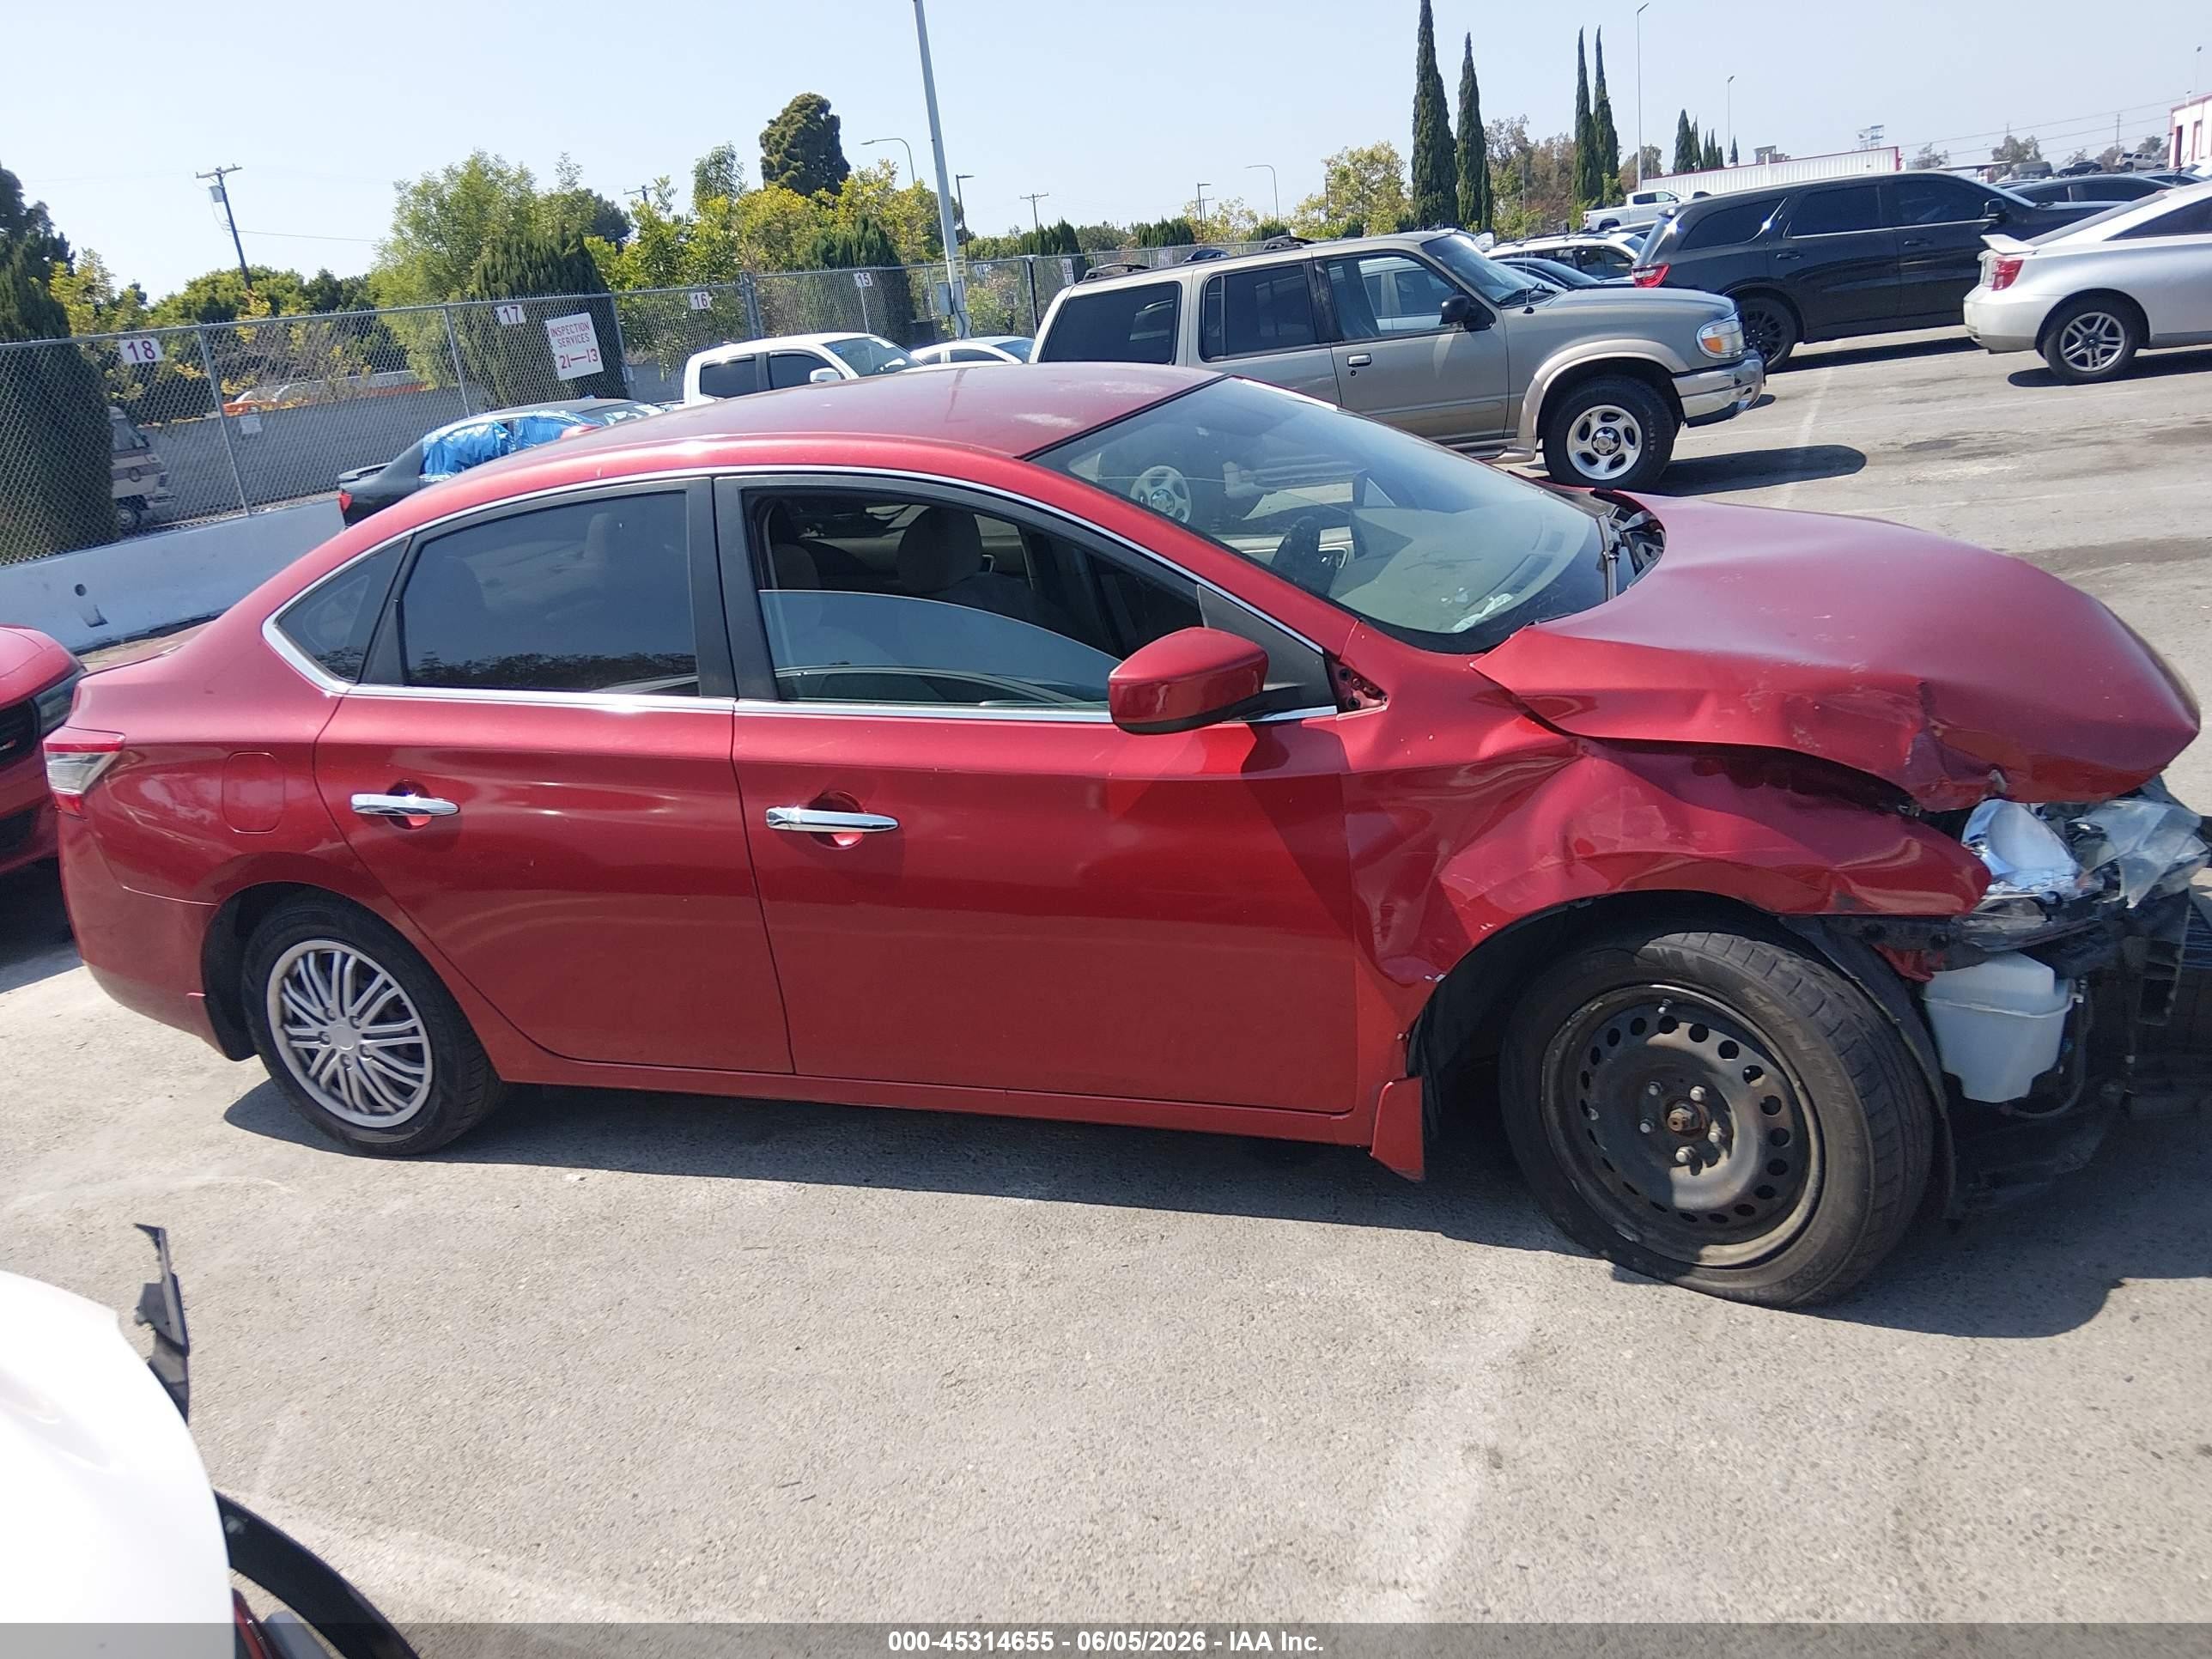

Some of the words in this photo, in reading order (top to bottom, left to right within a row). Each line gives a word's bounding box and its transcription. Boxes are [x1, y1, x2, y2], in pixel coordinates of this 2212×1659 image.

[858, 273, 870, 286] 15
[694, 293, 708, 308] 16
[503, 306, 520, 324] 17
[550, 322, 591, 337] INSPECTION
[558, 332, 591, 349] SERVICES
[127, 340, 156, 362] 18
